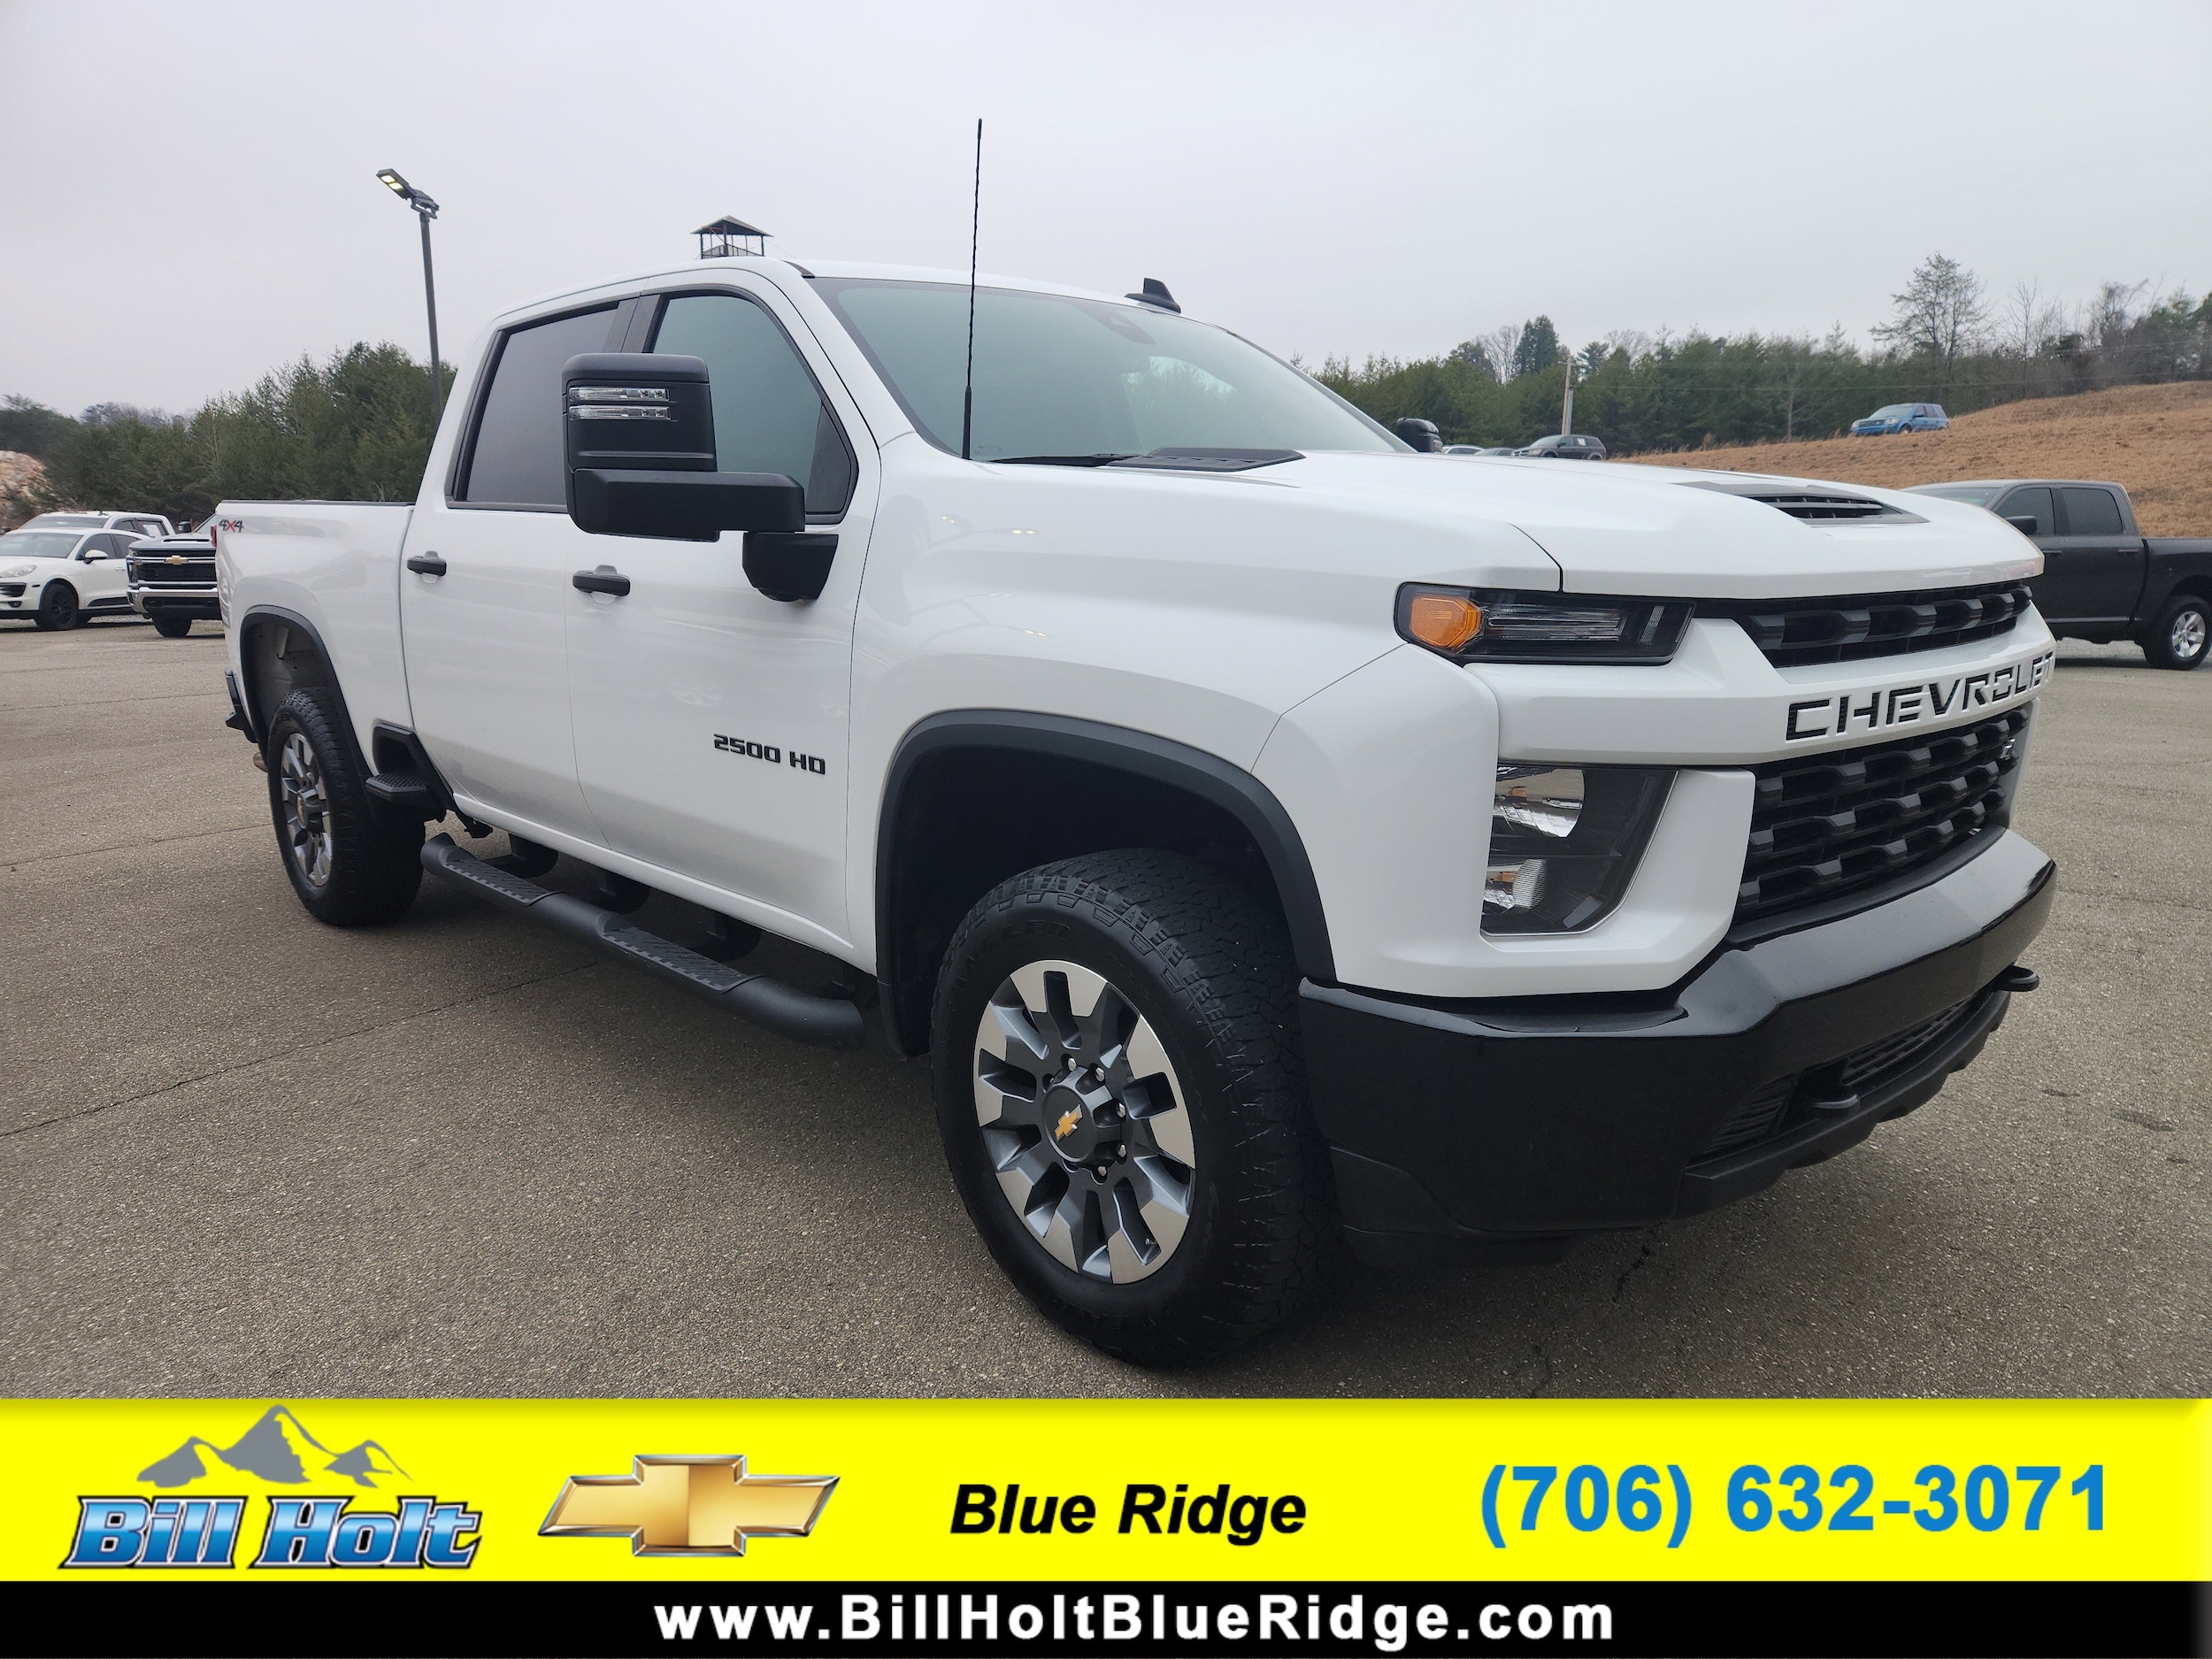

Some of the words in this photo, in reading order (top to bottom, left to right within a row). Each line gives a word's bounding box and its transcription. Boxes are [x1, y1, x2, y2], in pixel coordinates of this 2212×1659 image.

[1786, 651, 2054, 741] CHEVROLET
[713, 733, 781, 764] 2500
[789, 750, 826, 775] HD
